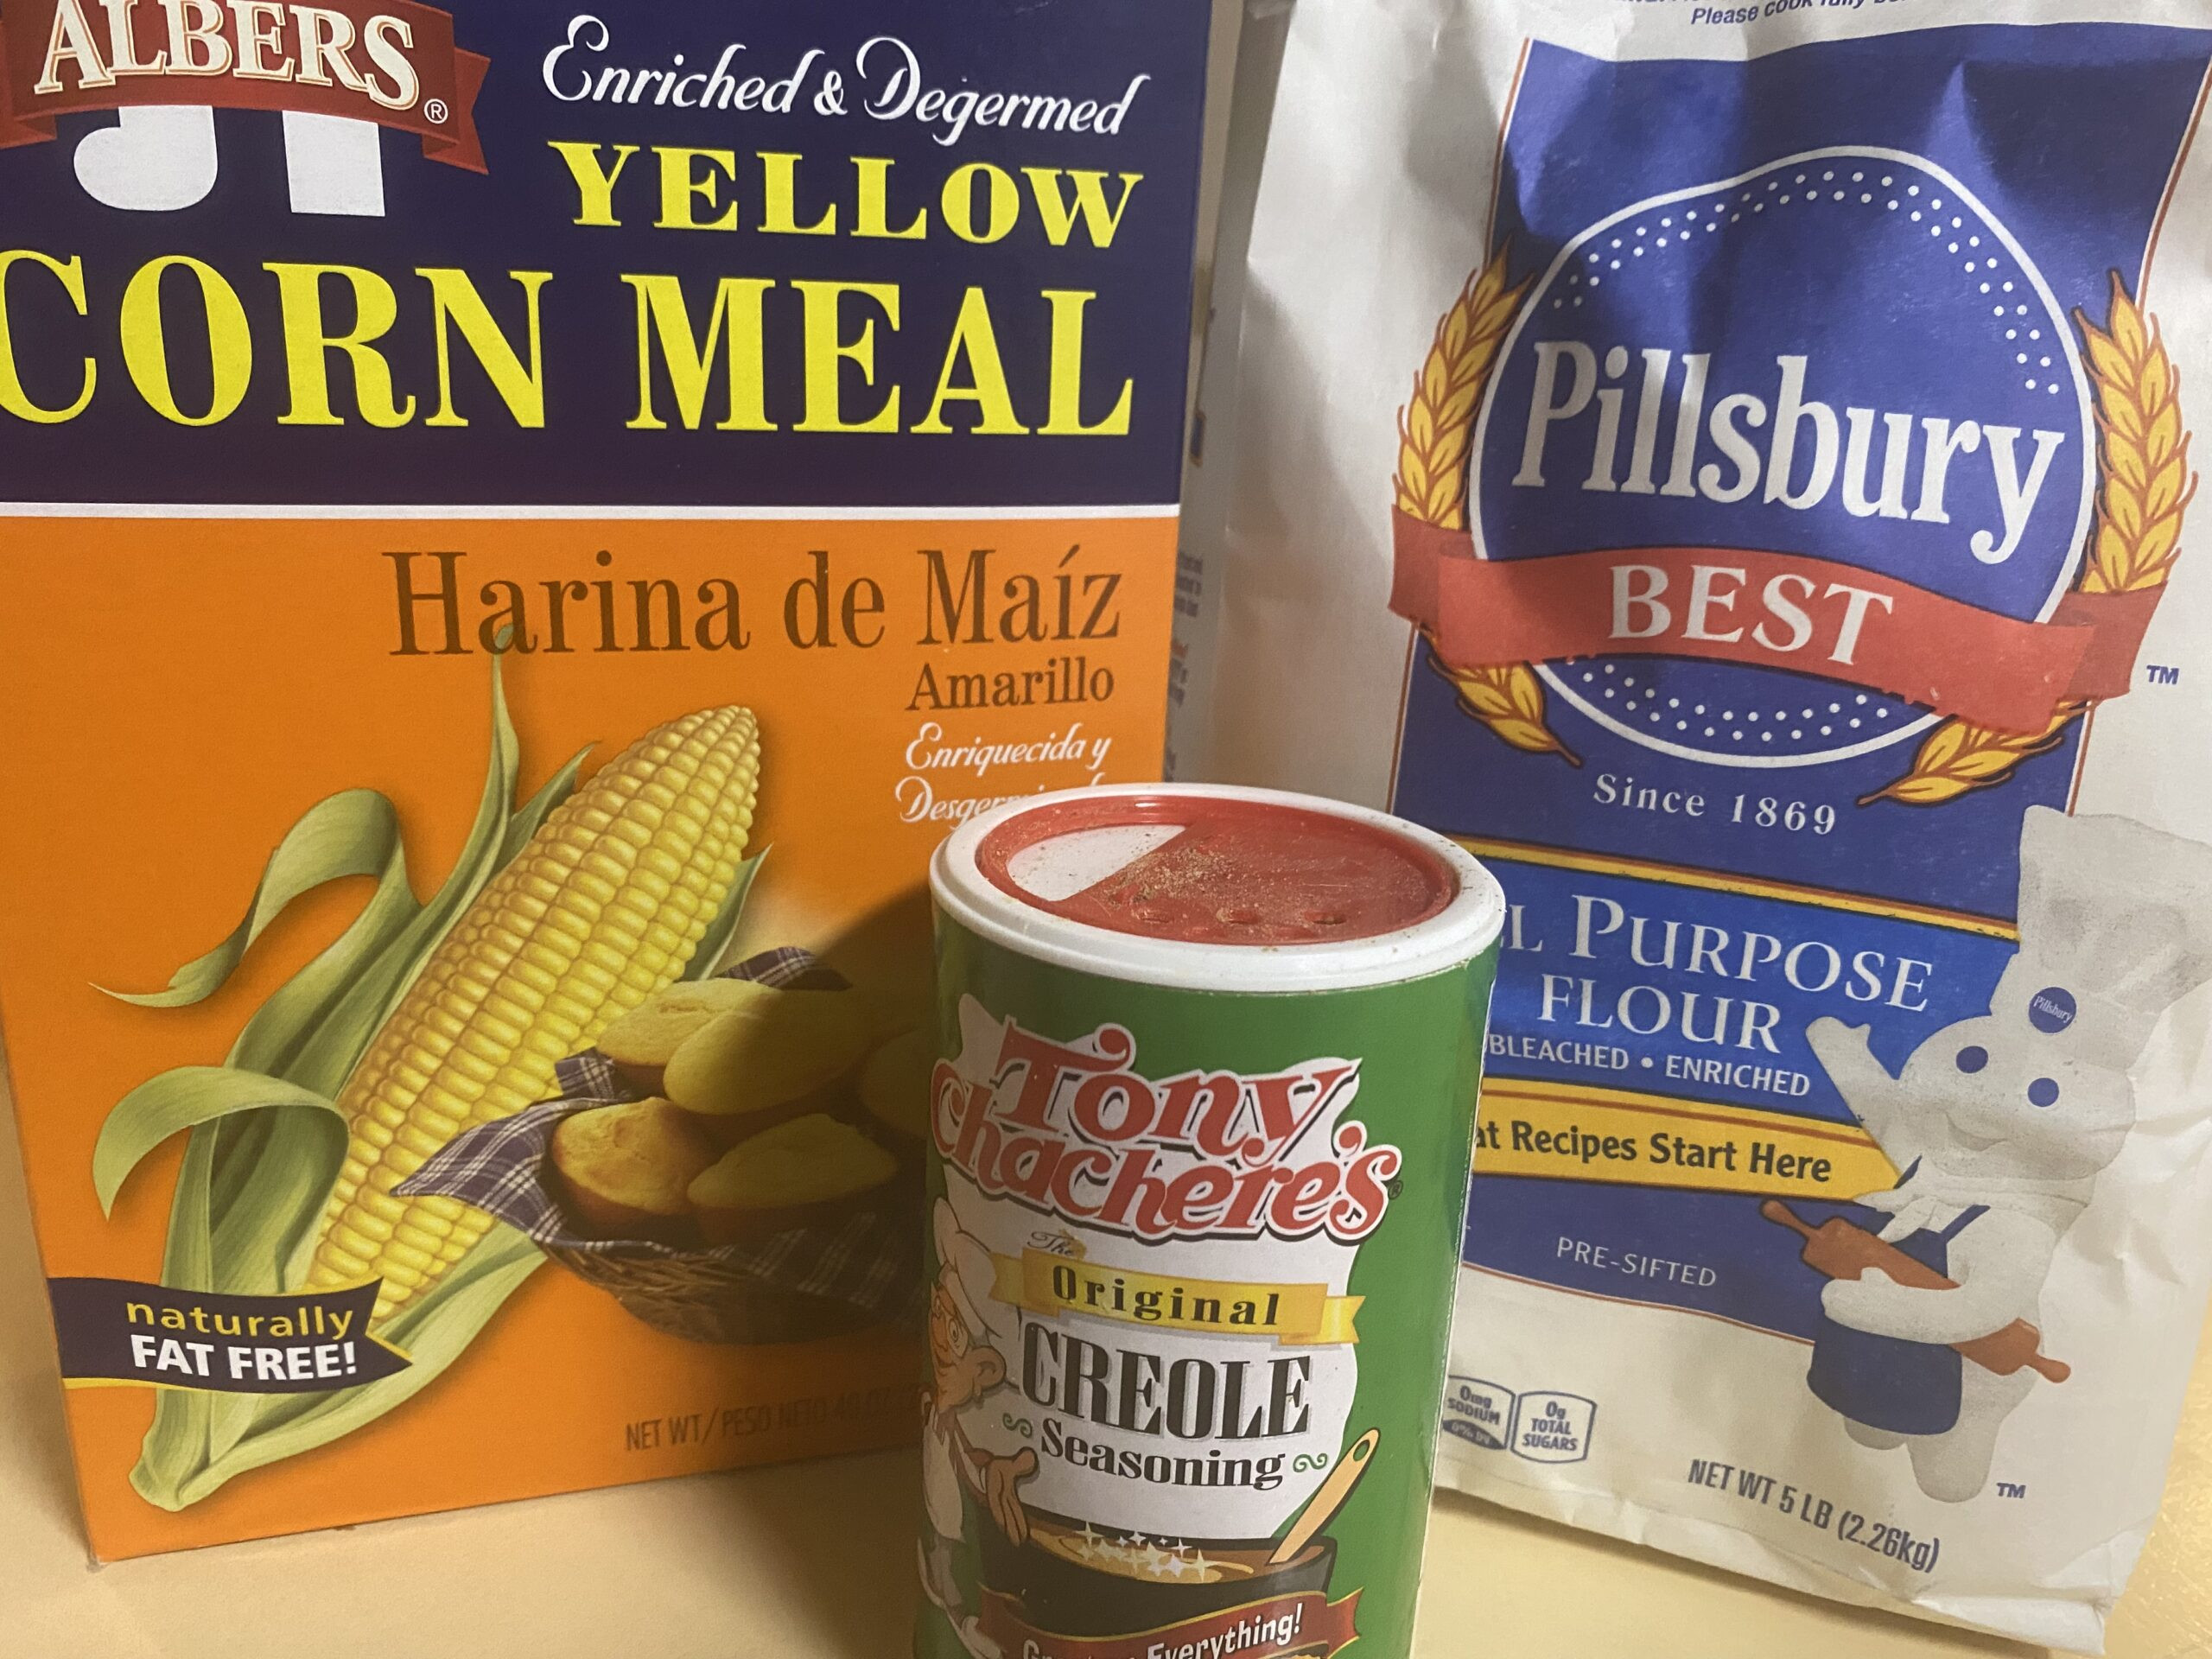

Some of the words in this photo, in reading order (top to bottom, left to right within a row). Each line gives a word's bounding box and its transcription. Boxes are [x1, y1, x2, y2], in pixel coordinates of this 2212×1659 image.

[1690, 7, 1758, 25] Please
[33, 0, 420, 109] ALBERS
[543, 15, 825, 113] Enriched
[813, 73, 848, 115] &
[856, 37, 1151, 146] Degermed
[548, 141, 1143, 248] YELLOW
[0, 250, 553, 429] CORN
[621, 274, 1133, 435] MEAL
[1512, 341, 2065, 564] Pillsbury
[383, 550, 751, 656] Harina
[785, 551, 886, 650] de
[916, 544, 1122, 646] Maíz
[1609, 564, 1894, 666] BEST
[906, 658, 1115, 711] Amarillo
[906, 721, 1086, 777] Enriquecida
[1085, 737, 1113, 771] y
[1594, 773, 1706, 817] Since
[1731, 795, 1837, 836] 1869
[1573, 894, 1934, 1013] PURPOSE
[1537, 974, 1782, 1053] FLOUR
[2033, 995, 2073, 1024] Pillsbury
[992, 1023, 1353, 1166] Tony
[1666, 1055, 1810, 1096] ENRICHED
[931, 1062, 1398, 1236] Chachere's
[1511, 1120, 1637, 1164] Recipes
[1649, 1133, 1737, 1172] Start
[1749, 1142, 1831, 1182] Here
[1027, 1231, 1076, 1256] The
[1556, 1236, 1717, 1287] PRE-SIFTED
[126, 1301, 353, 1340] naturally
[1052, 1264, 1279, 1325] Original
[130, 1334, 214, 1376] FAT
[227, 1341, 357, 1380] FREE!
[1020, 1322, 1311, 1440] CREOLE
[626, 1418, 662, 1451] NET
[1447, 1397, 1501, 1426] SODIUM
[1531, 1418, 1571, 1435] TOTAL
[1545, 1401, 1567, 1420] 0g
[1041, 1418, 1285, 1490] Seasoning
[1522, 1433, 1579, 1452] SUGARS
[1688, 1459, 1735, 1491] NET
[1738, 1470, 1777, 1504] WT
[1778, 1485, 1796, 1514] 5
[1800, 1493, 1834, 1530] LB
[1837, 1510, 1940, 1573] (2.26kg)
[1147, 1603, 1303, 1659] Everything!
